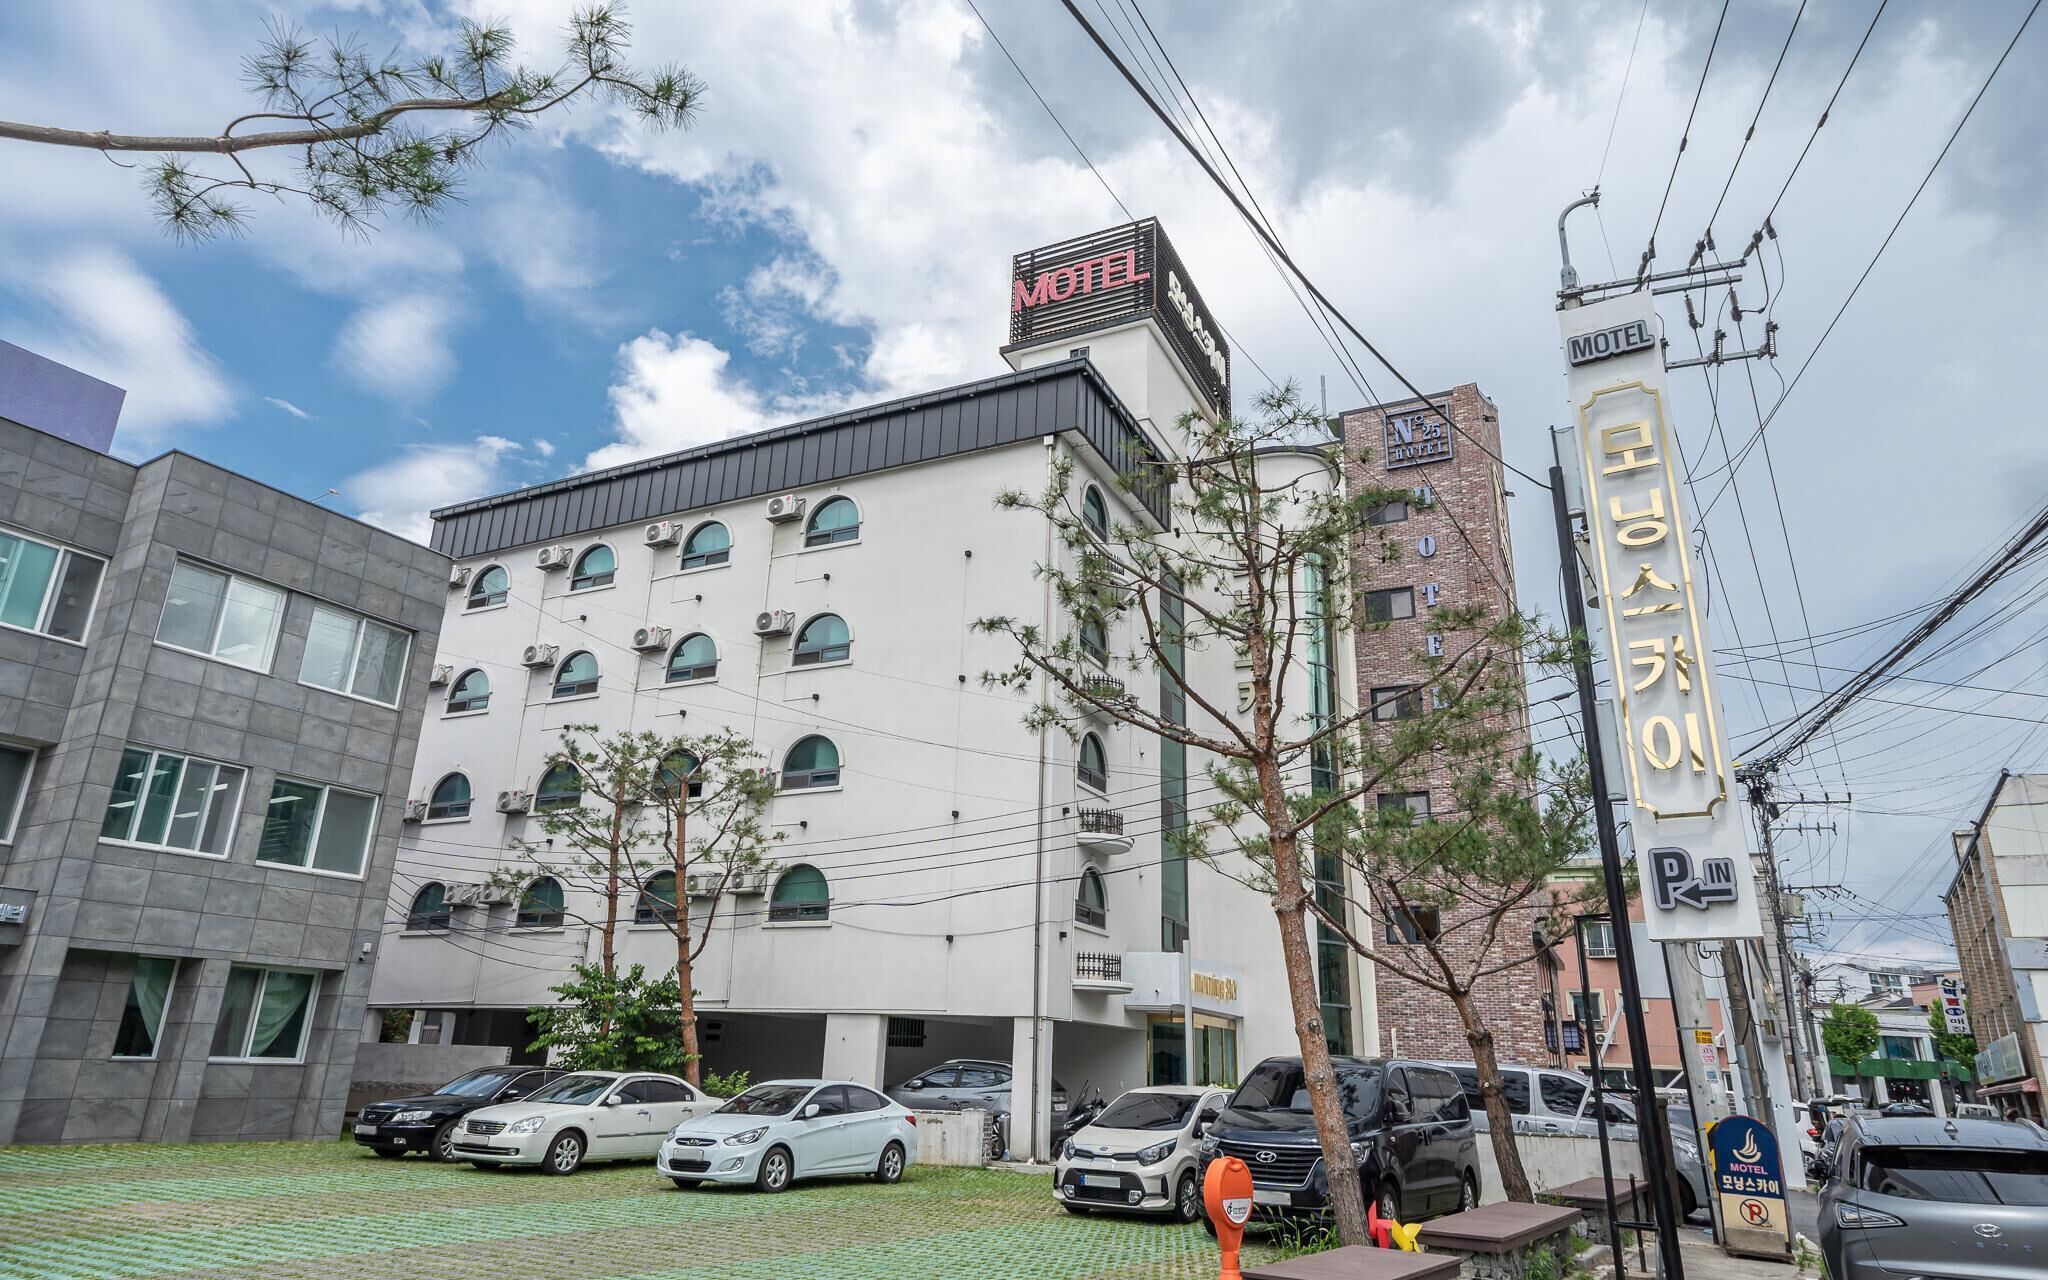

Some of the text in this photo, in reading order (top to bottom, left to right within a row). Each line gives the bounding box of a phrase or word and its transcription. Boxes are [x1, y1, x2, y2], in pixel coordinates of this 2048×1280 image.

[1014, 249, 1150, 312] MOTEL
[1571, 323, 1652, 360] MOTEL
[1422, 423, 1441, 440] 25
[1395, 440, 1447, 460] HOTEL
[1600, 418, 1707, 776] 모닝스카이
[1707, 861, 1732, 884] IN
[1730, 1162, 1769, 1175] MOTEL
[1722, 1174, 1780, 1195] 모닝스카이
